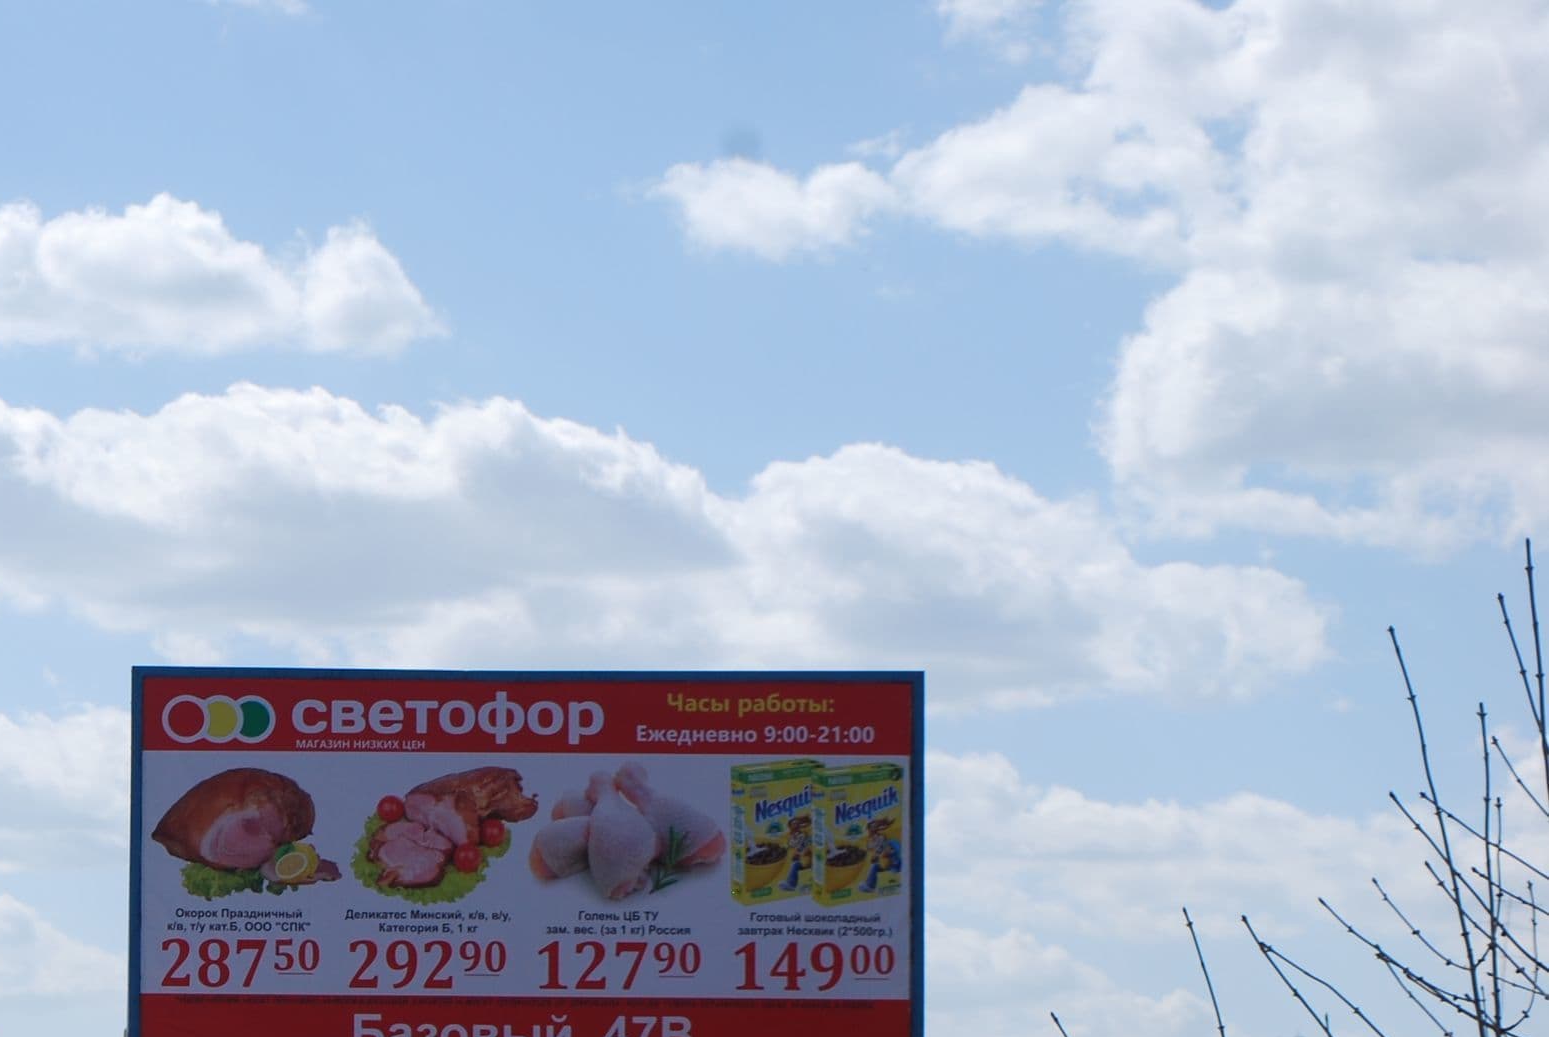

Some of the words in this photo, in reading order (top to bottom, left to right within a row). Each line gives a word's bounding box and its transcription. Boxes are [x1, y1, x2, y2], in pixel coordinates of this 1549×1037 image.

[666, 692, 730, 713] Часы
[737, 693, 835, 717] работы:
[635, 724, 758, 746] Ежедневно
[764, 726, 876, 744] 9:00-21:00
[295, 739, 350, 750] МАГАЗИН
[353, 739, 401, 750] НИЗКИХ
[402, 739, 426, 751] ЦЕН
[754, 783, 812, 824] Nesqui
[834, 785, 899, 825] Nesquik
[175, 908, 218, 920] Окорок
[220, 907, 303, 921] Праздничный
[344, 909, 407, 921] Деликатес
[410, 909, 466, 922] Минский,
[577, 911, 620, 922] Голень
[623, 911, 641, 923] ЦБ
[643, 911, 659, 922] ТУ
[749, 912, 801, 923] Готовый
[804, 912, 881, 924] шоколадный
[166, 921, 187, 933] к/в,
[189, 921, 207, 932] т/у
[244, 921, 273, 932] ООО
[275, 921, 311, 932] "СПК"
[379, 923, 440, 935] Категория
[441, 923, 455, 935] Б,
[458, 924, 465, 933] 1
[466, 925, 478, 934] кг
[545, 926, 571, 936] зам.
[574, 926, 597, 936] вес.
[599, 924, 618, 938] (за
[621, 925, 628, 935] 1
[630, 924, 646, 938] кг)
[648, 925, 692, 936] Россия
[737, 926, 784, 936] завтрак
[786, 925, 834, 937] Несквик
